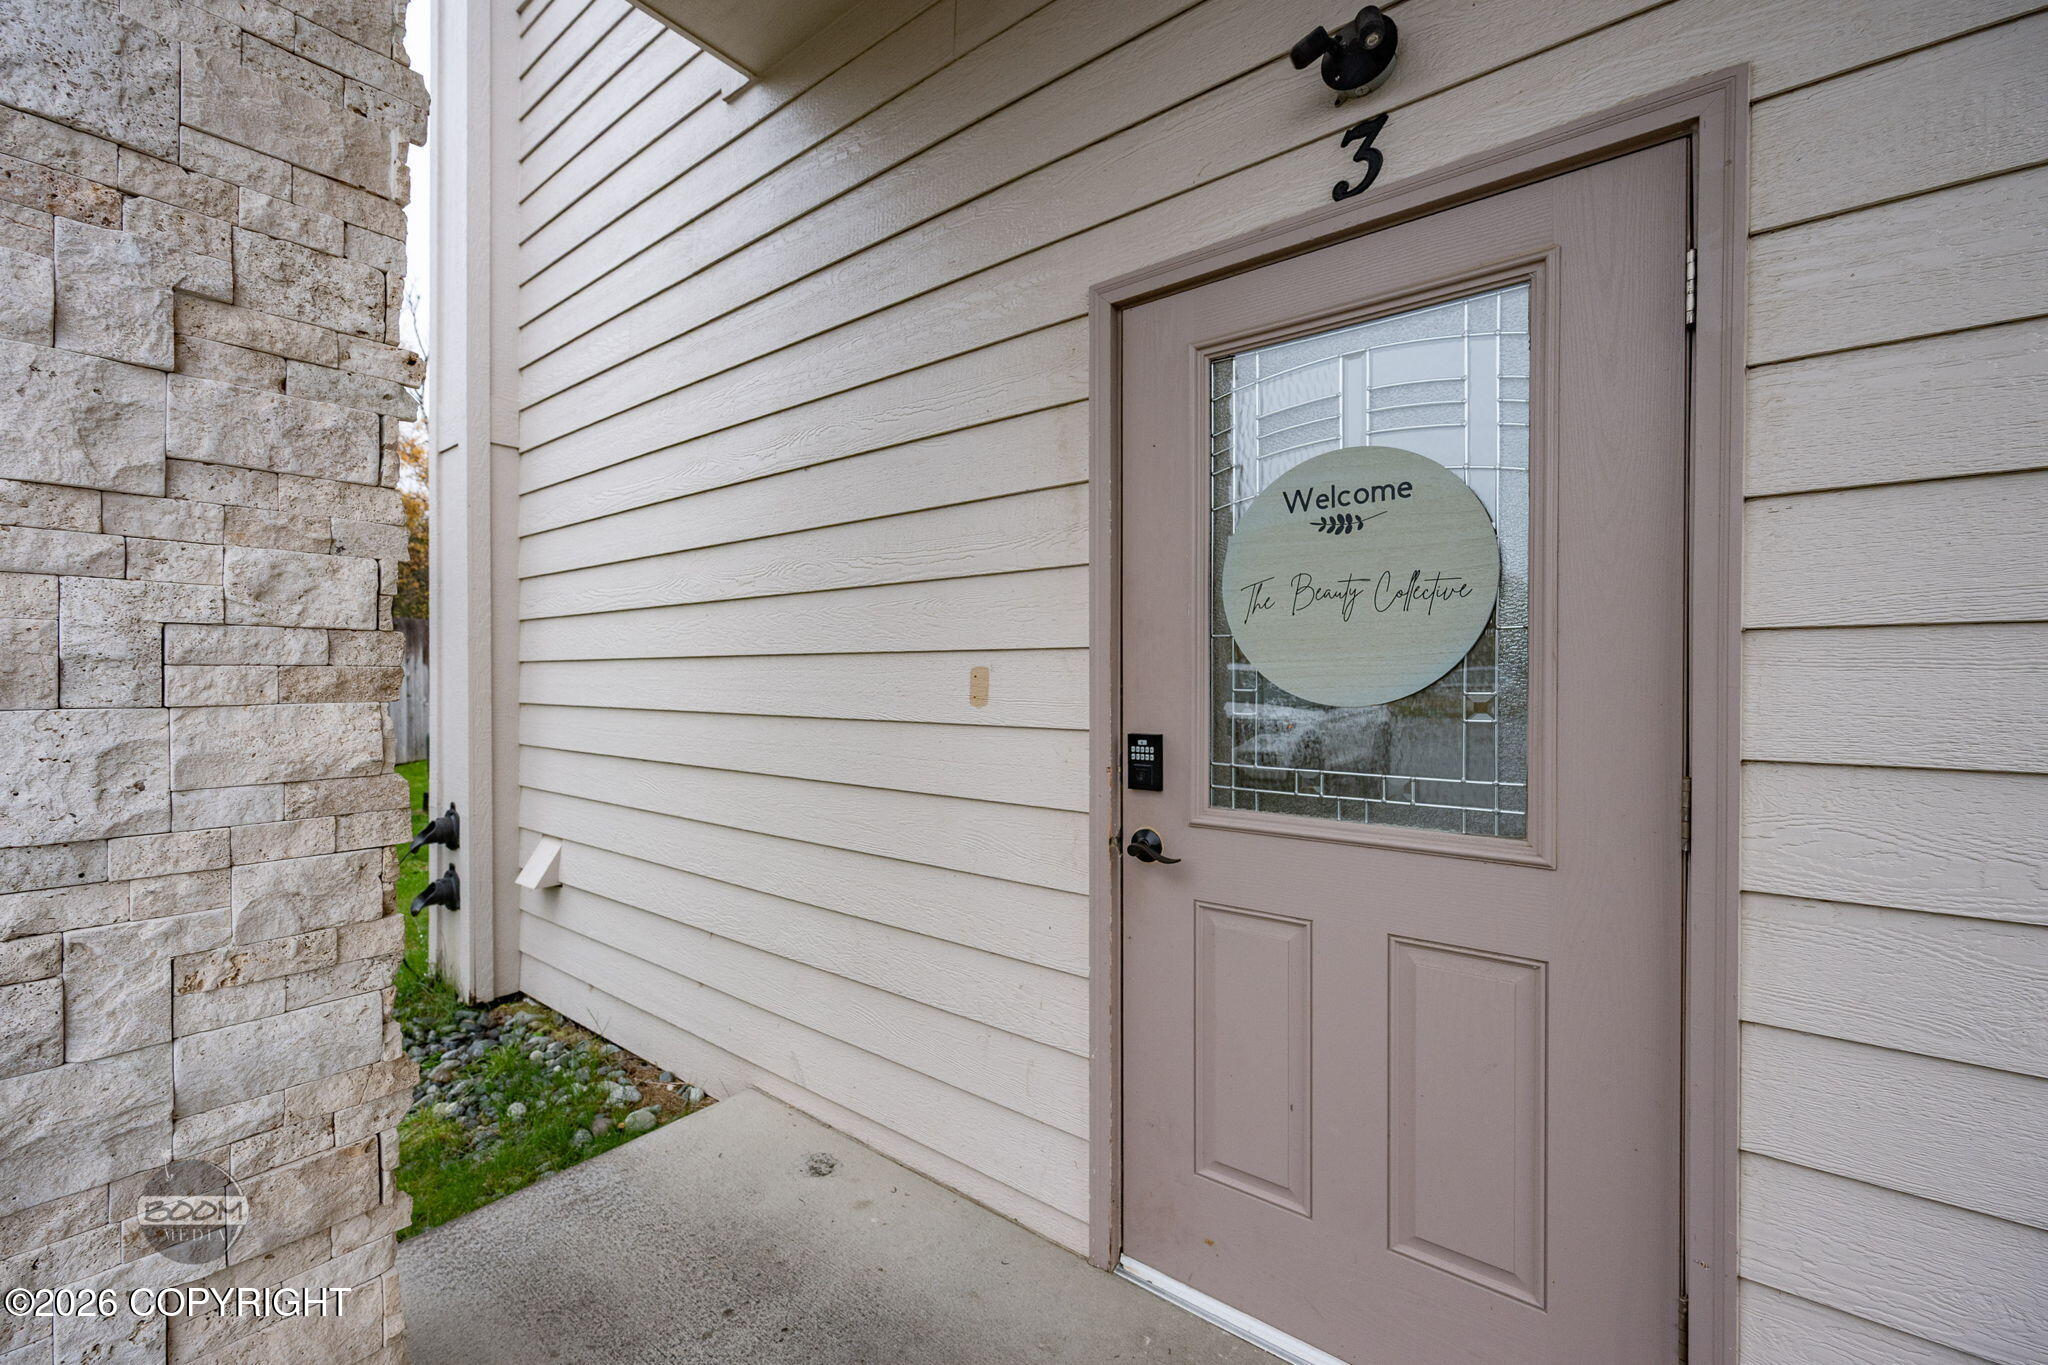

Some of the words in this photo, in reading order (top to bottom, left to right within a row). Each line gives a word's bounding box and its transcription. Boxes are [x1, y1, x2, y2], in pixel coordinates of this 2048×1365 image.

[1332, 112, 1389, 202] 3
[1283, 481, 1413, 514] Welcome
[1241, 576, 1276, 625] The
[1290, 572, 1371, 622] Beauty
[1374, 569, 1473, 616] Collective
